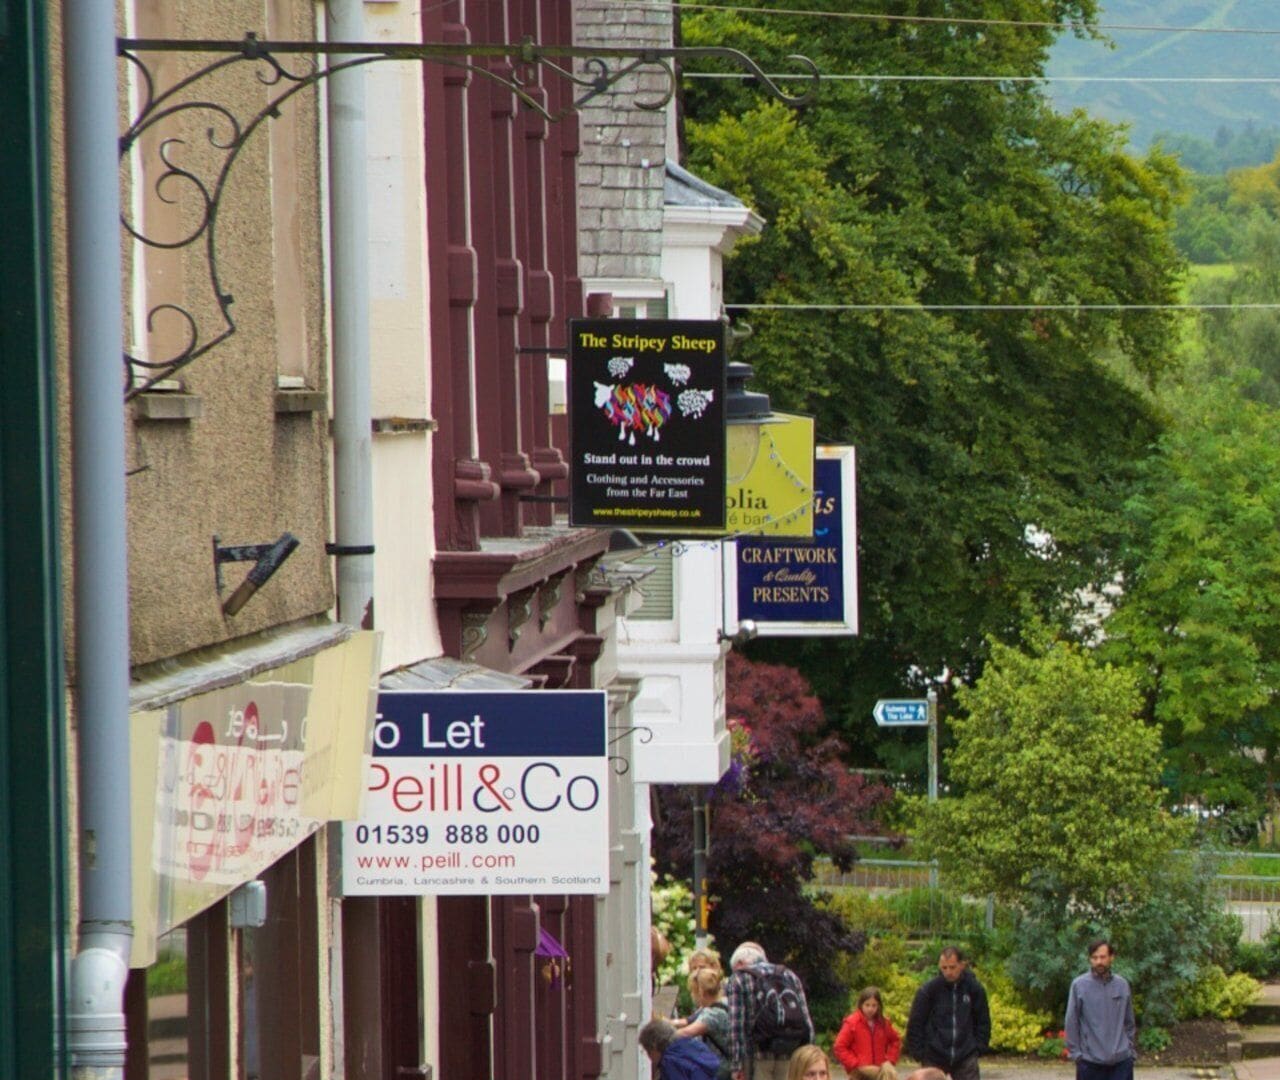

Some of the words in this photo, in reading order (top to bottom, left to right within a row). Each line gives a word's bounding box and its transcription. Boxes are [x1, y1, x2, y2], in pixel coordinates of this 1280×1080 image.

[580, 333, 607, 348] The
[612, 333, 666, 351] Stripey
[671, 335, 716, 353] Sheep
[584, 453, 616, 465] Stand
[619, 455, 638, 465] out
[641, 454, 652, 465] in
[656, 454, 674, 465] the
[676, 455, 710, 467] crowd
[587, 473, 627, 487] Clothing
[630, 475, 648, 485] and
[651, 475, 705, 486] Accessories
[607, 488, 629, 497] from
[632, 488, 647, 497] the
[650, 488, 665, 498] Far
[668, 489, 688, 499] East
[593, 507, 701, 519] www.thestripeysheep.co.uk
[742, 547, 837, 563] CRAFTWORK
[753, 586, 830, 603] PRESENTS
[422, 713, 485, 749] Let
[356, 824, 429, 844] 01539
[445, 824, 488, 844] 888
[497, 824, 540, 844] 000
[414, 876, 474, 885] Lancashire
[481, 876, 489, 885] &
[495, 876, 546, 885] Southern
[552, 876, 601, 885] Scotland
